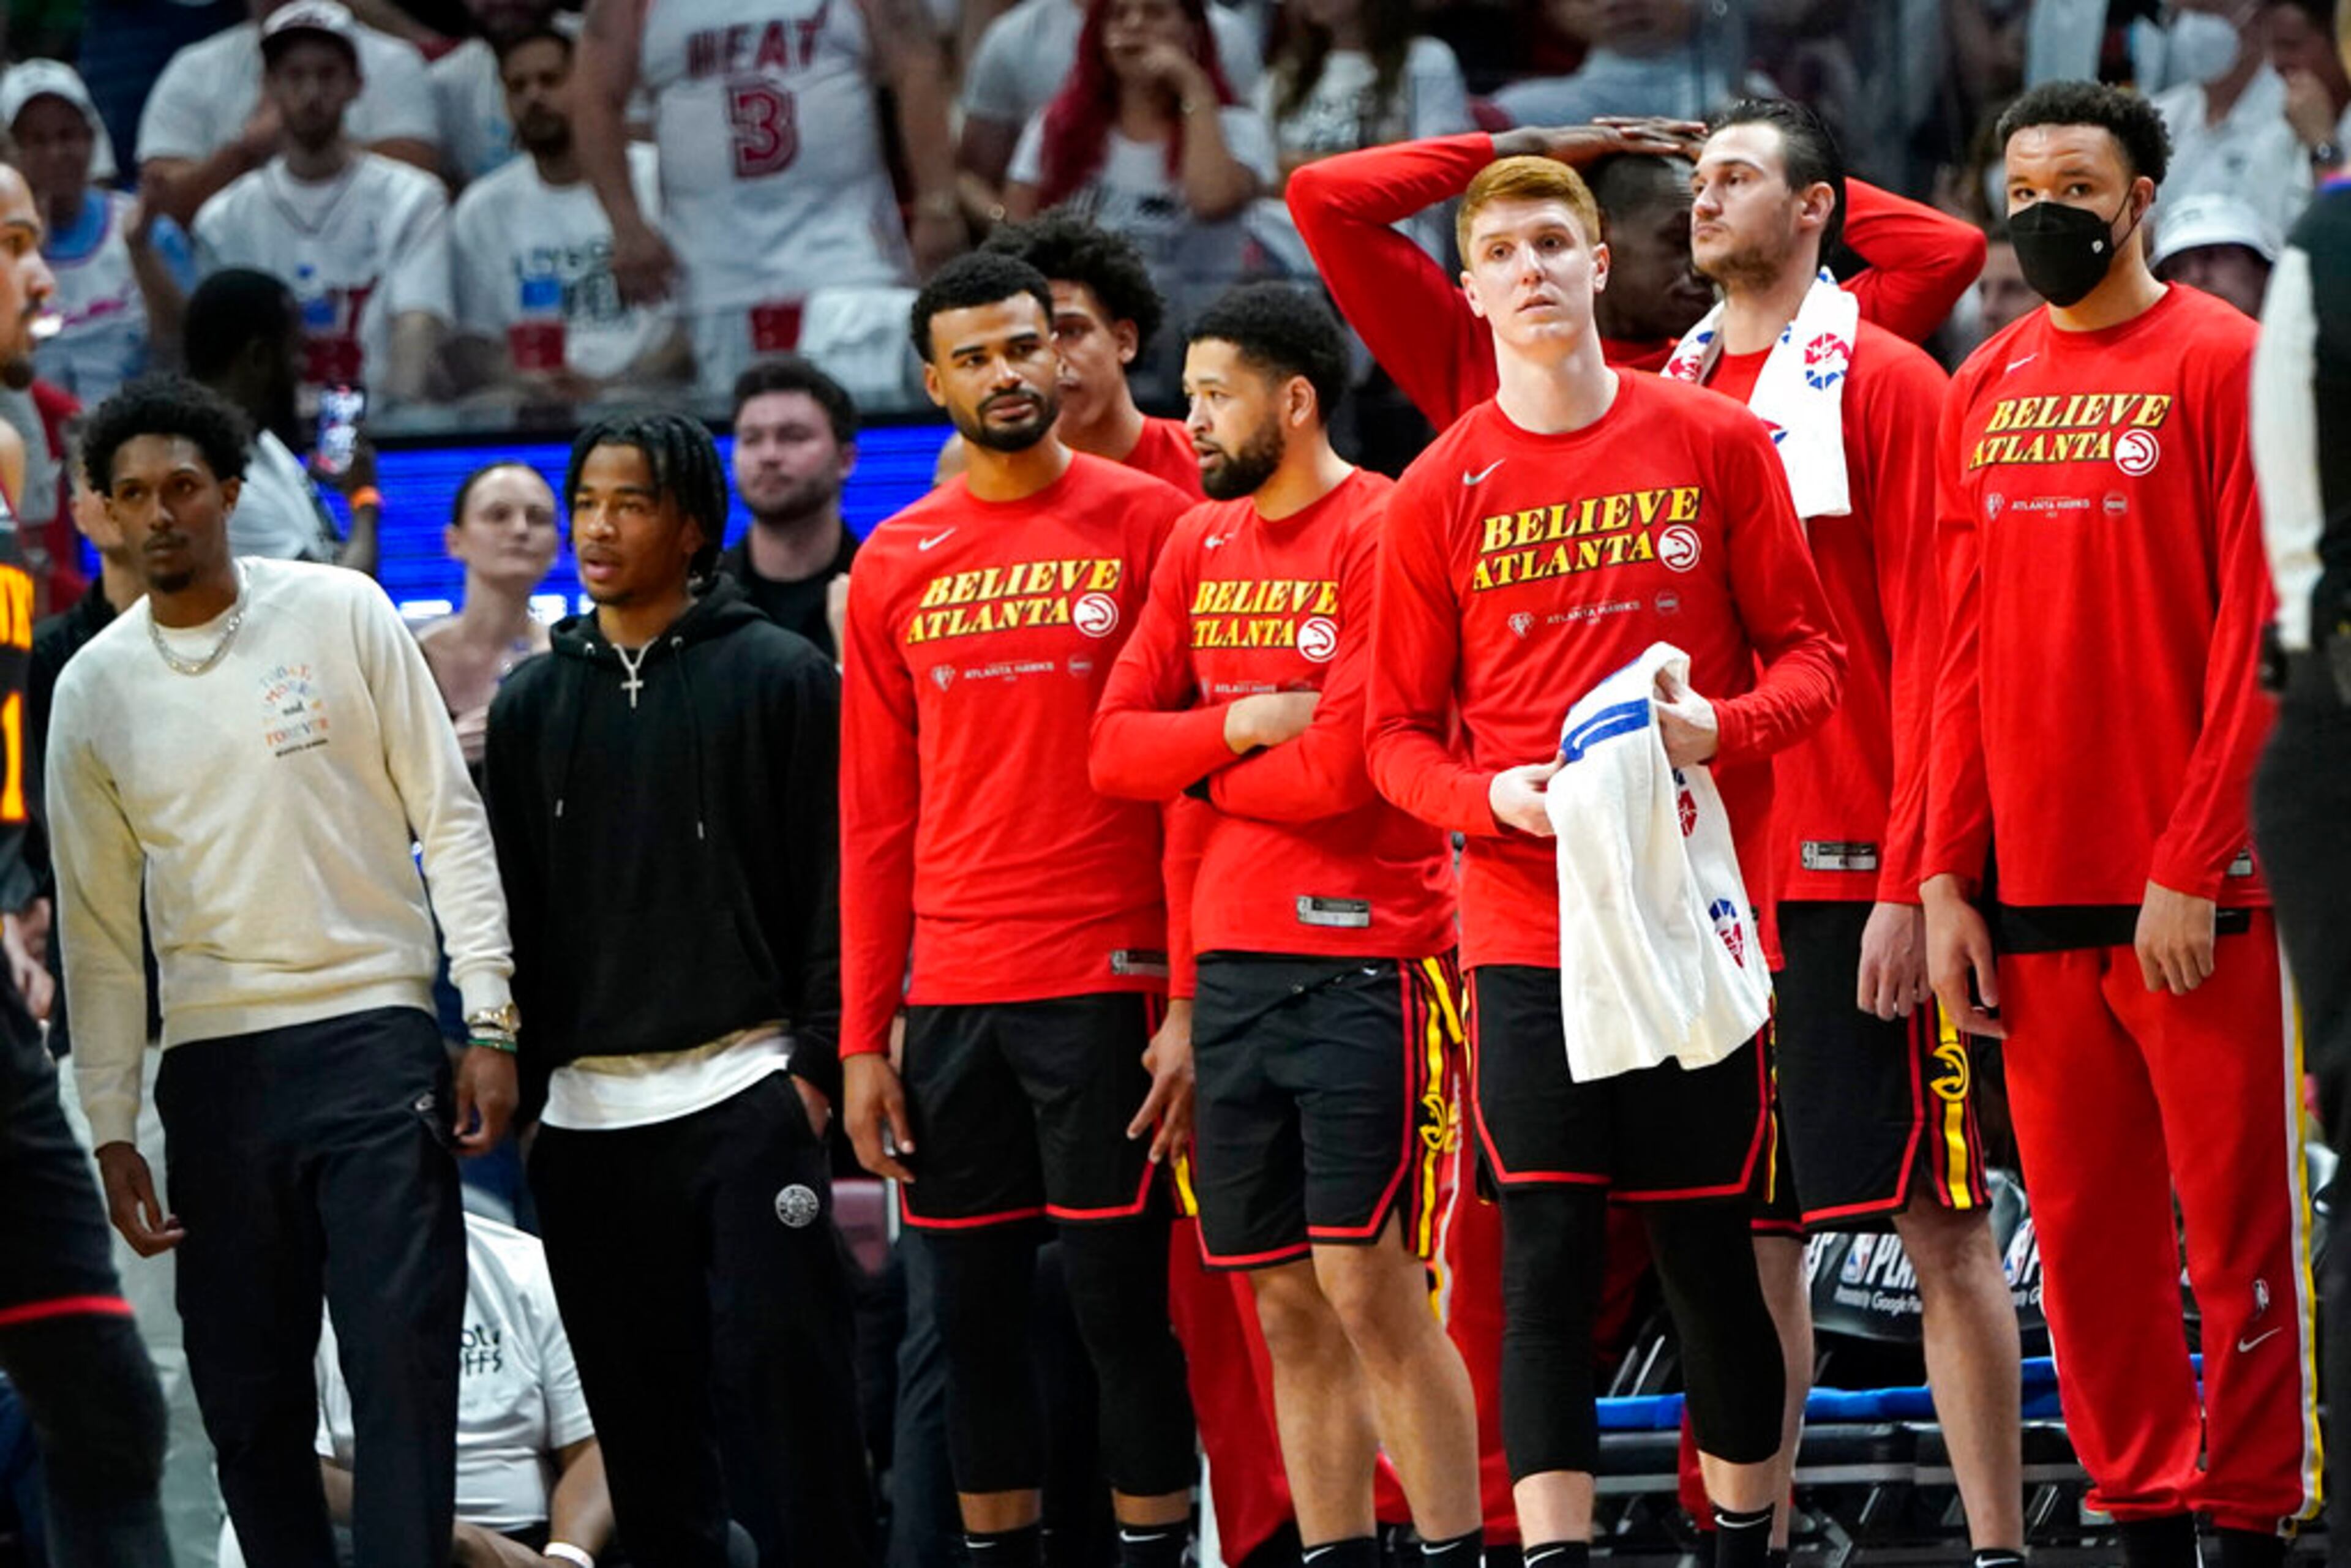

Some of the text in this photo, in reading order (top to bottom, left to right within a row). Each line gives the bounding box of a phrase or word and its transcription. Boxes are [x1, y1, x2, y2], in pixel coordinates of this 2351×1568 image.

[686, 11, 823, 81] HEAT
[727, 84, 800, 180] 3
[1984, 392, 2173, 433] BELIEVE
[1968, 430, 2112, 471] ATLANTA
[1479, 486, 1701, 555] BELIEVE
[918, 558, 1122, 608] BELIEVE
[1472, 530, 1655, 592] ATLANTA
[907, 595, 1071, 644] ATLANTA
[1190, 579, 1339, 615] BELIEVE
[1190, 617, 1297, 648] TLANTA
